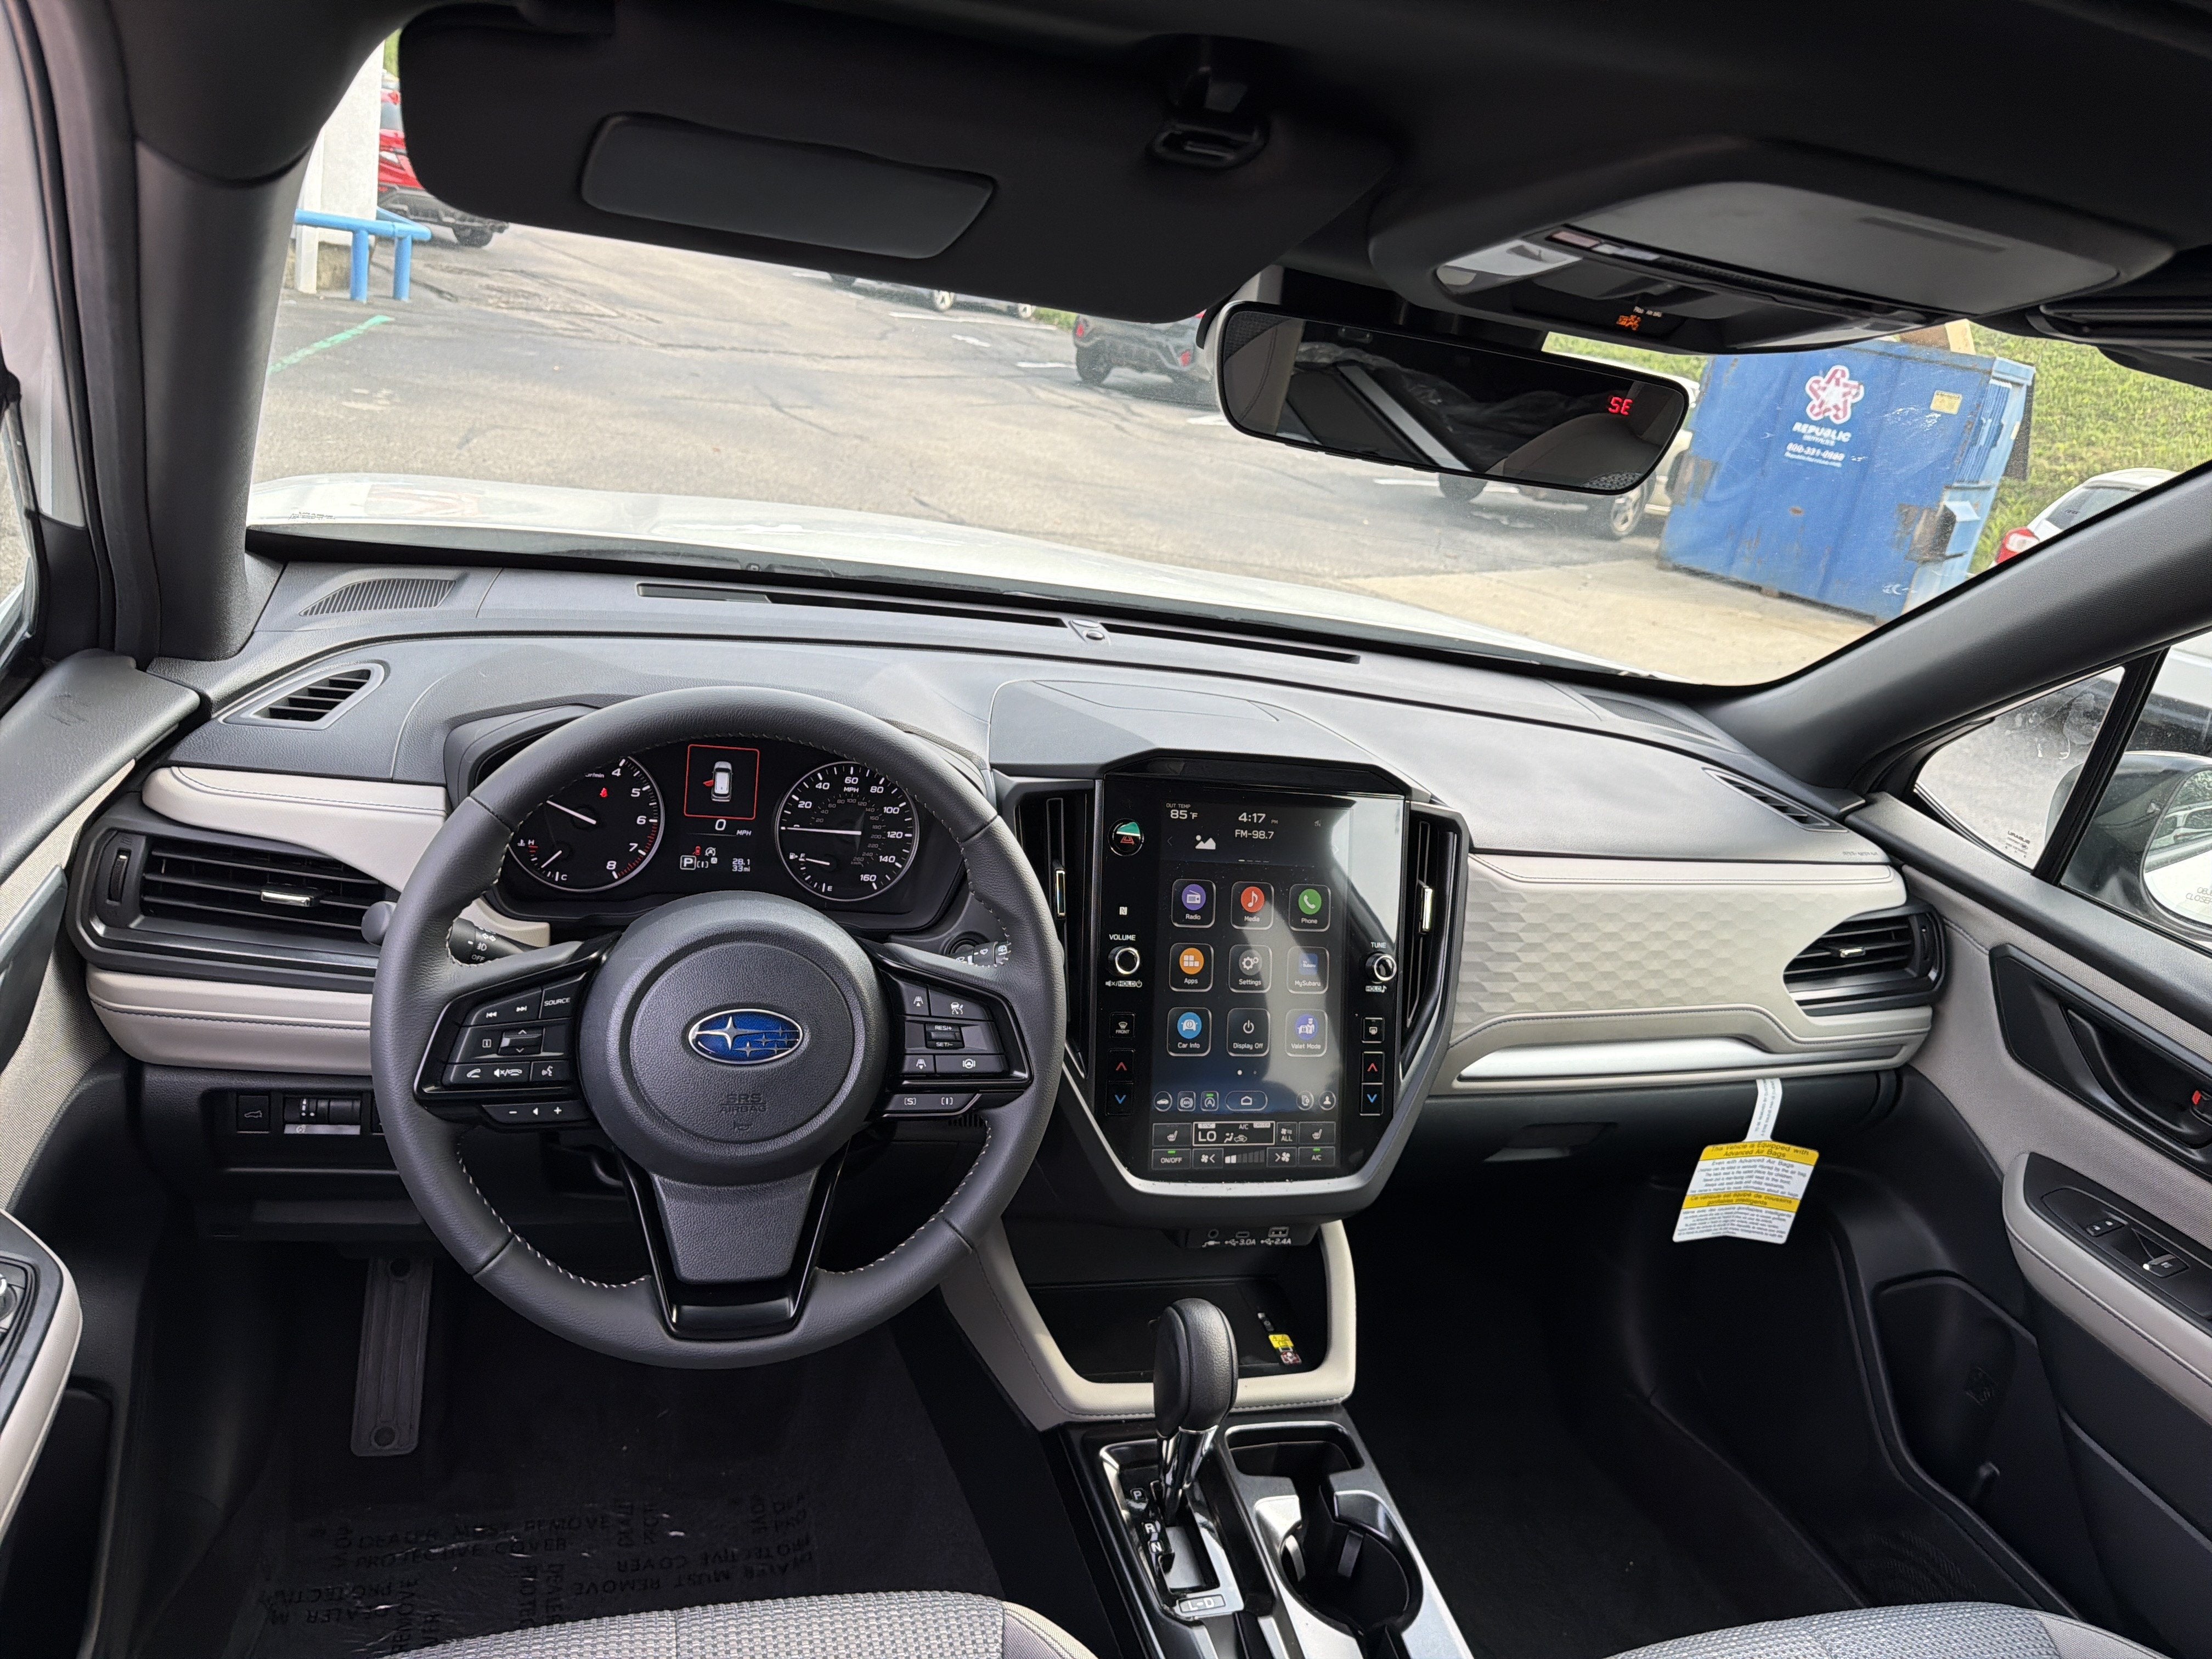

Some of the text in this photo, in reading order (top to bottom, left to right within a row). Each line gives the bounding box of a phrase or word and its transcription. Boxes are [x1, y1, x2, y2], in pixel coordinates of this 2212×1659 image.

[1608, 397, 1633, 416] SE
[1792, 422, 1852, 442] REPUBLIC
[612, 768, 621, 776] 4
[631, 788, 640, 797] 5
[1170, 810, 1187, 820] 85
[1238, 812, 1266, 823] 4:17
[636, 816, 647, 825] 6
[715, 819, 726, 831] 0
[1235, 830, 1274, 839] FM-98.7
[629, 843, 638, 851] 7
[606, 861, 617, 870] 8
[684, 857, 693, 867] P
[544, 997, 571, 1007] SOURCE
[727, 1093, 763, 1104] SRS
[1198, 1131, 1216, 1142] LO
[1757, 1142, 1790, 1152] Equipped
[1767, 1150, 1786, 1158] Bags
[1133, 1491, 1142, 1500] P
[1145, 1523, 1154, 1534] R
[1152, 1543, 1161, 1552] N
